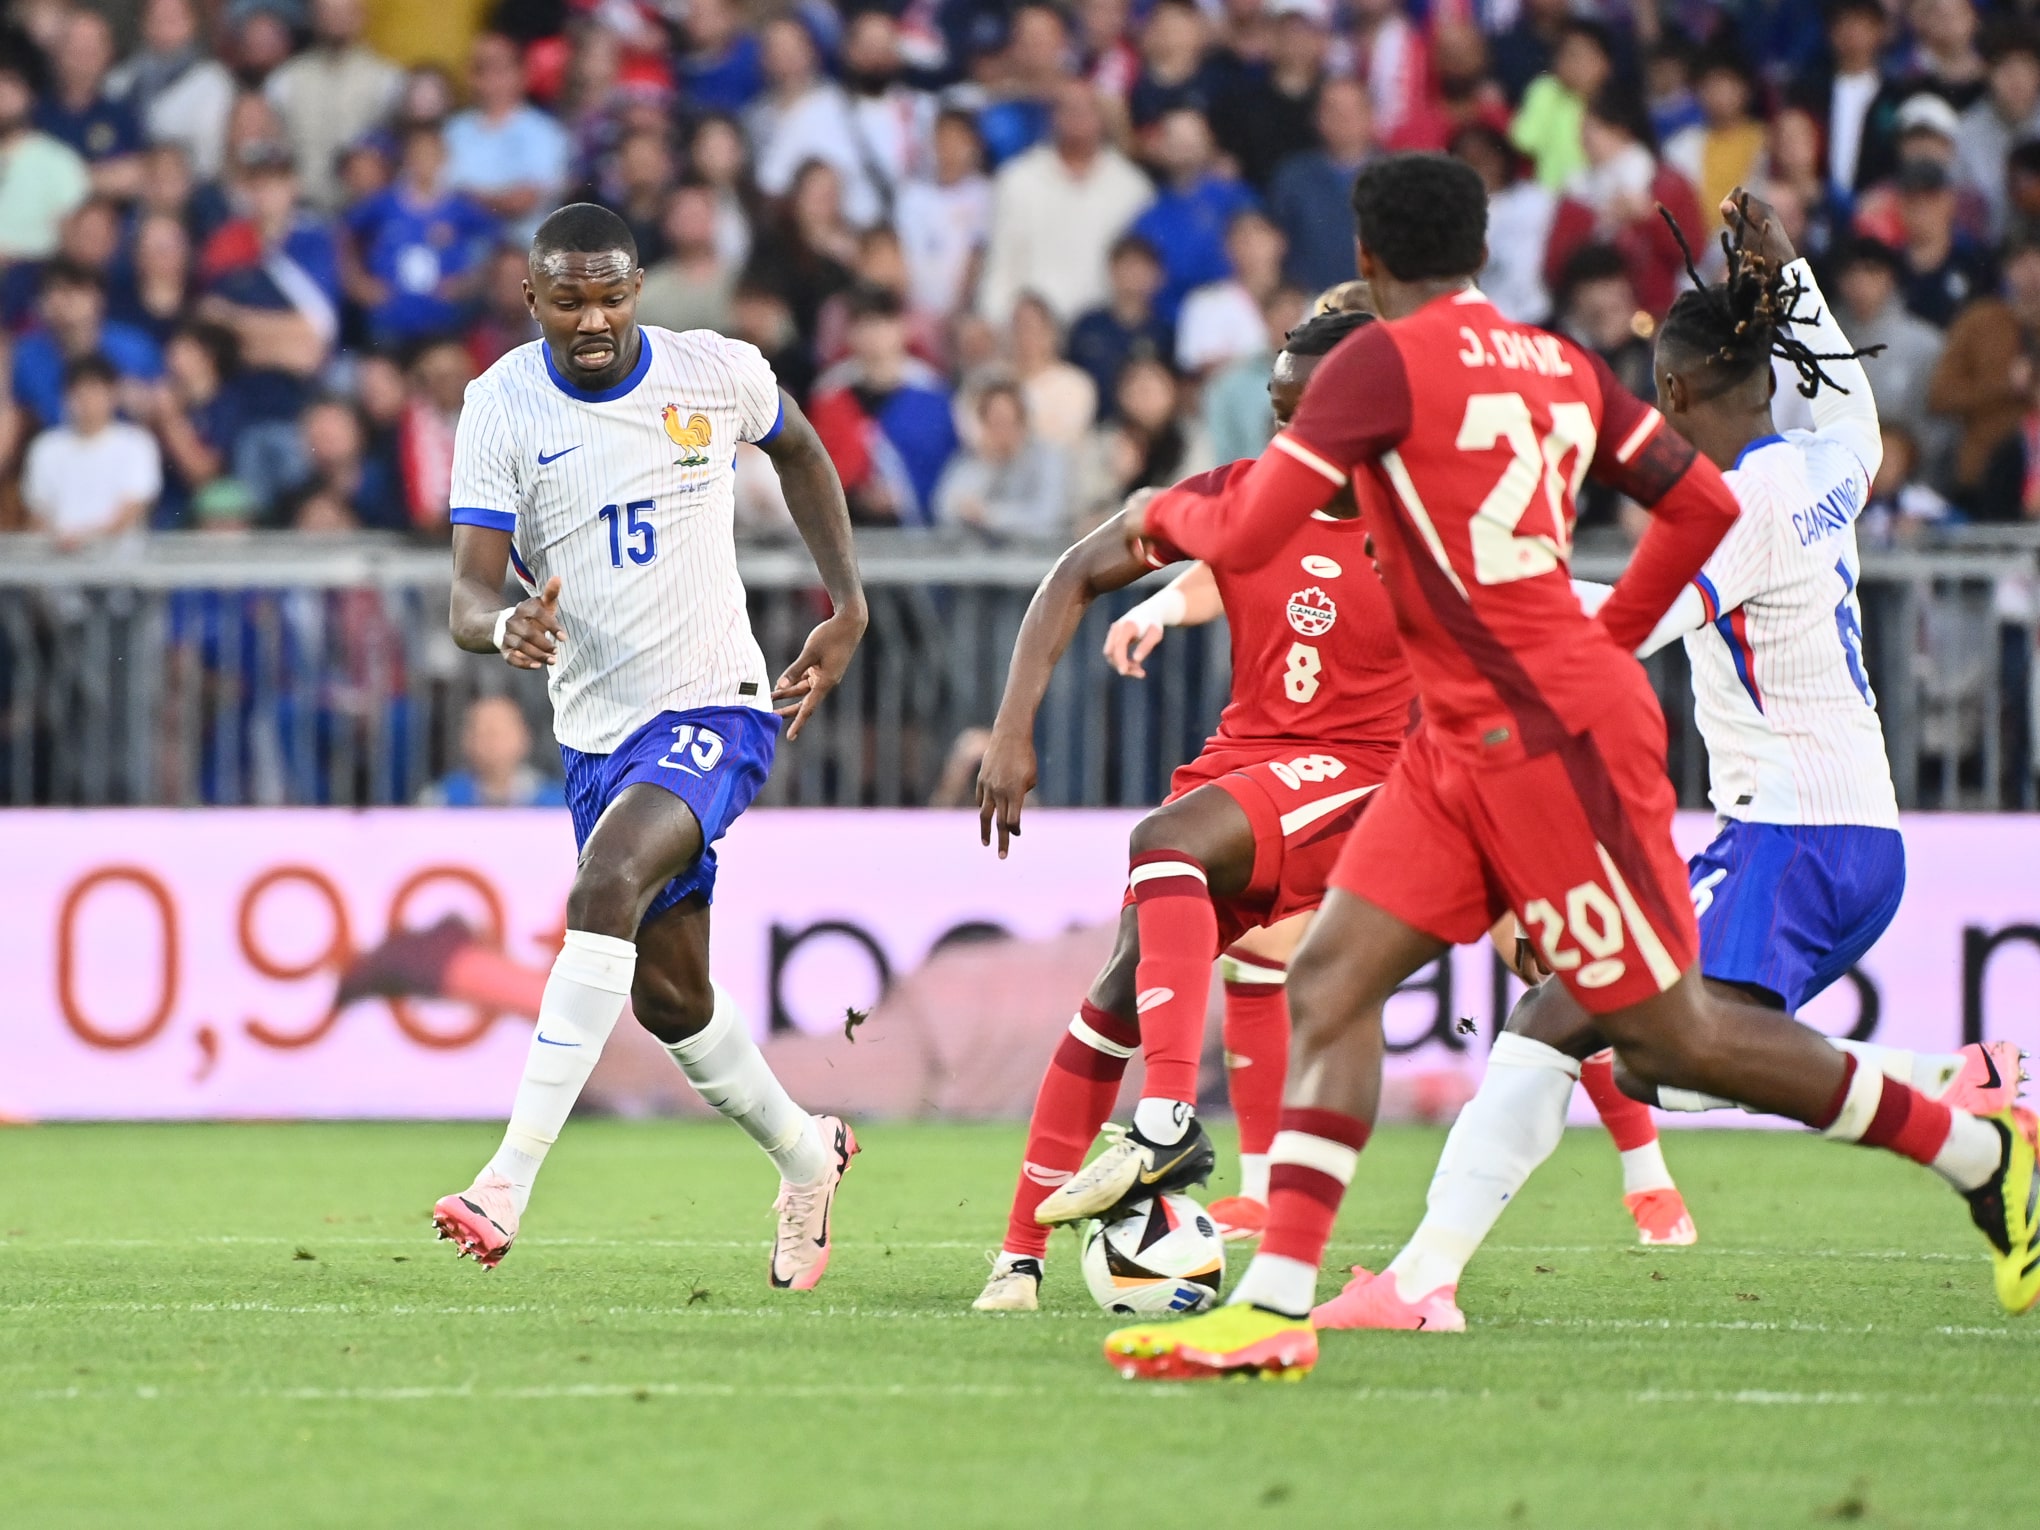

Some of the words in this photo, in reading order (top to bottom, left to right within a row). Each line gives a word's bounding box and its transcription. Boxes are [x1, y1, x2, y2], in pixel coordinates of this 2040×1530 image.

[1459, 325, 1496, 367] J.
[1454, 391, 1597, 586] 20
[1792, 477, 1858, 547] CAMAVING
[598, 499, 658, 569] 15
[1289, 604, 1333, 620] CANADA
[1283, 641, 1322, 704] 8
[670, 724, 724, 772] 15
[1287, 753, 1348, 783] 8
[1524, 879, 1624, 971] 20
